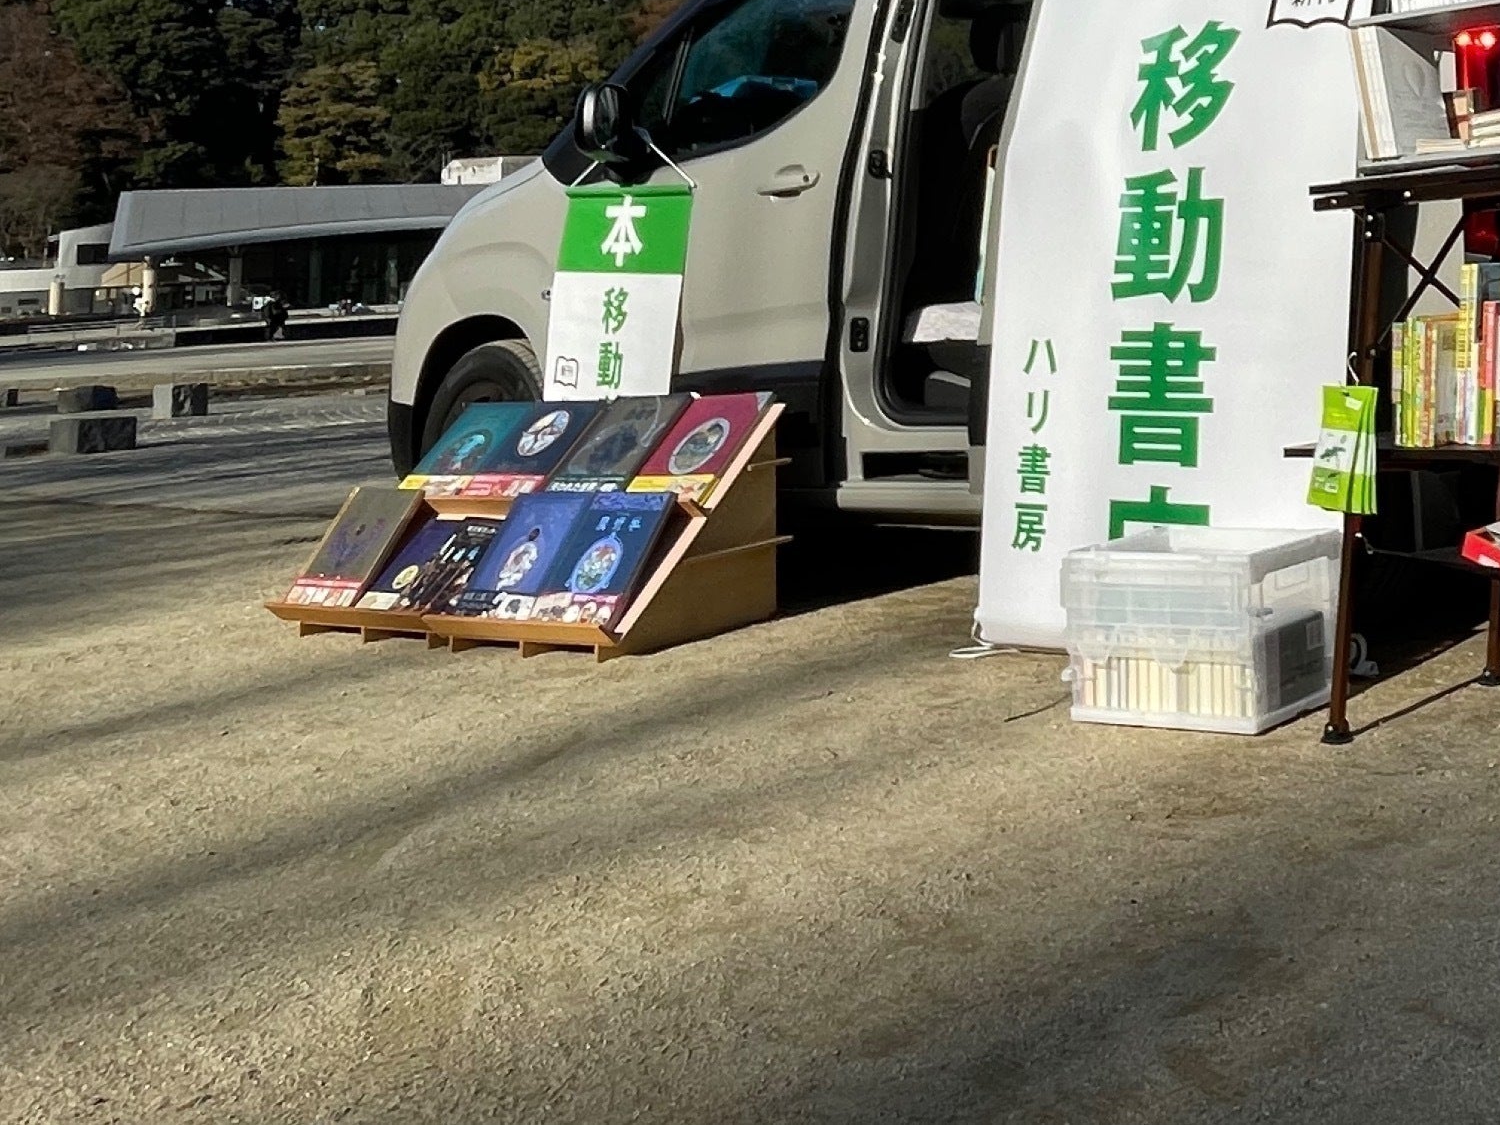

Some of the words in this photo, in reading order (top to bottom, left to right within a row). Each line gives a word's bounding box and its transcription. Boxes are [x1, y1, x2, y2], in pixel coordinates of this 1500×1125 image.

[600, 195, 647, 268] 本
[1011, 338, 1058, 552] ハリ書房
